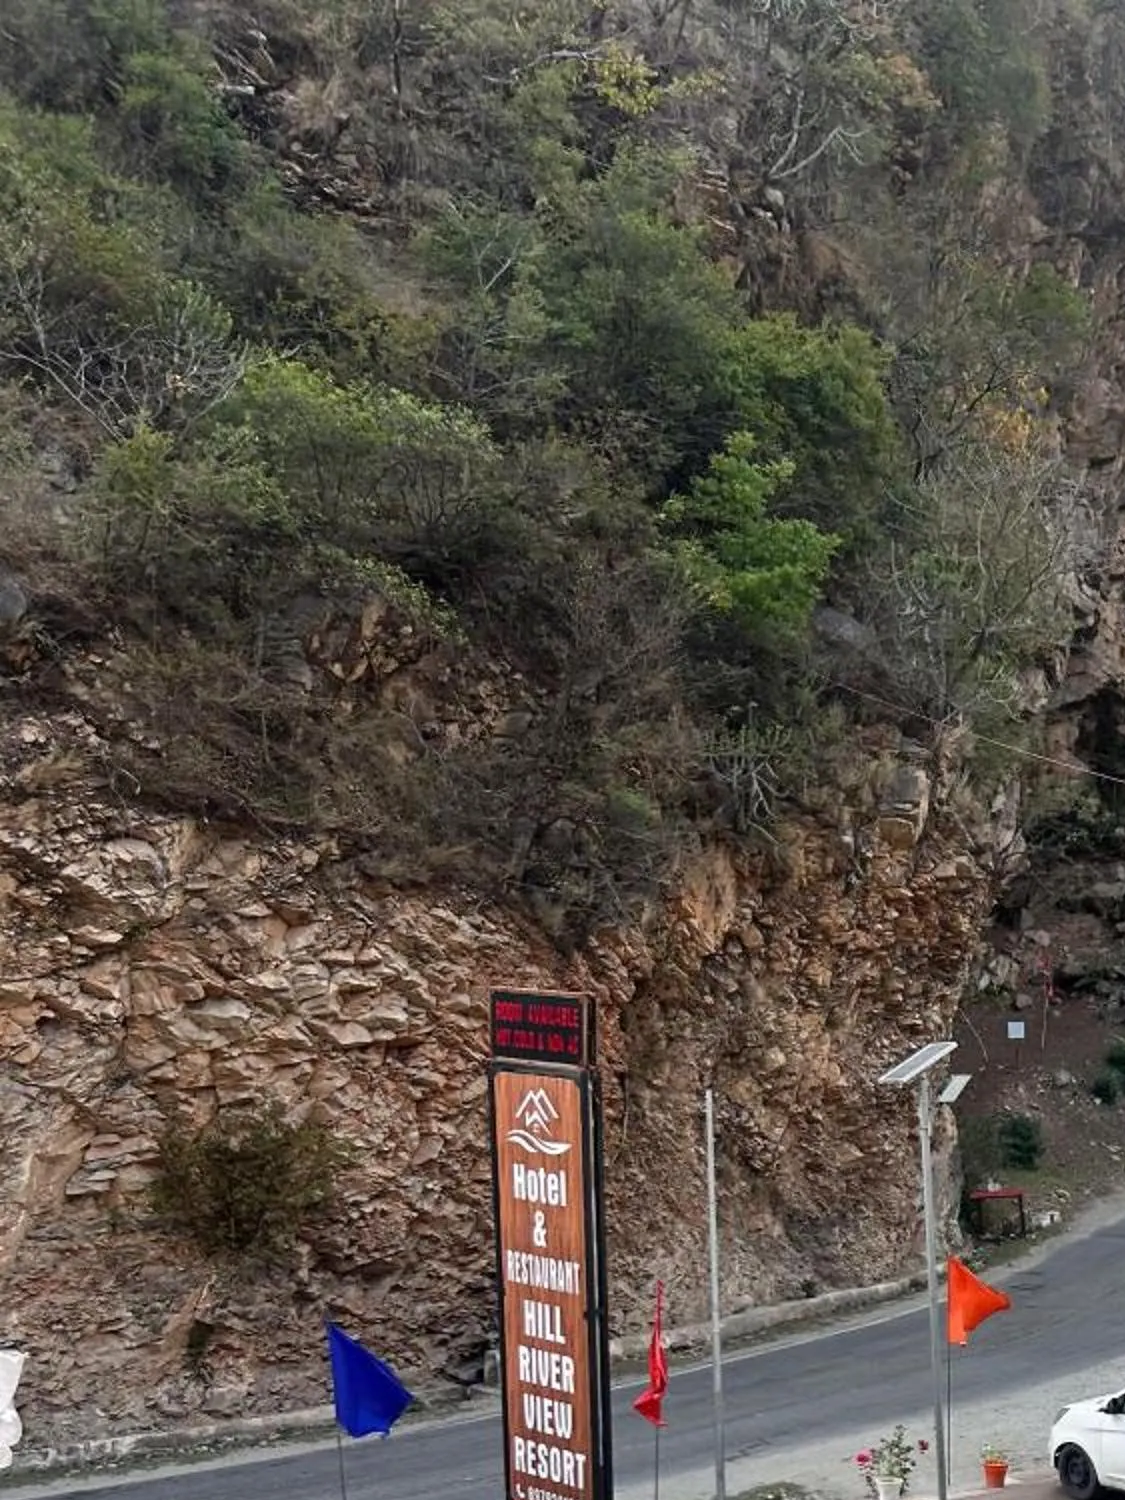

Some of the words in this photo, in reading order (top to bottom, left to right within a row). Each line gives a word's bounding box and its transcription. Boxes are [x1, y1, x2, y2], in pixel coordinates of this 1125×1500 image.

[512, 1163, 567, 1206] Hotel
[533, 1211, 547, 1247] &
[508, 1250, 579, 1294] RESTAURANT
[524, 1300, 566, 1344] HILL
[518, 1345, 575, 1394] RIVER
[524, 1394, 572, 1439] VIEW
[515, 1437, 586, 1489] RESORT
